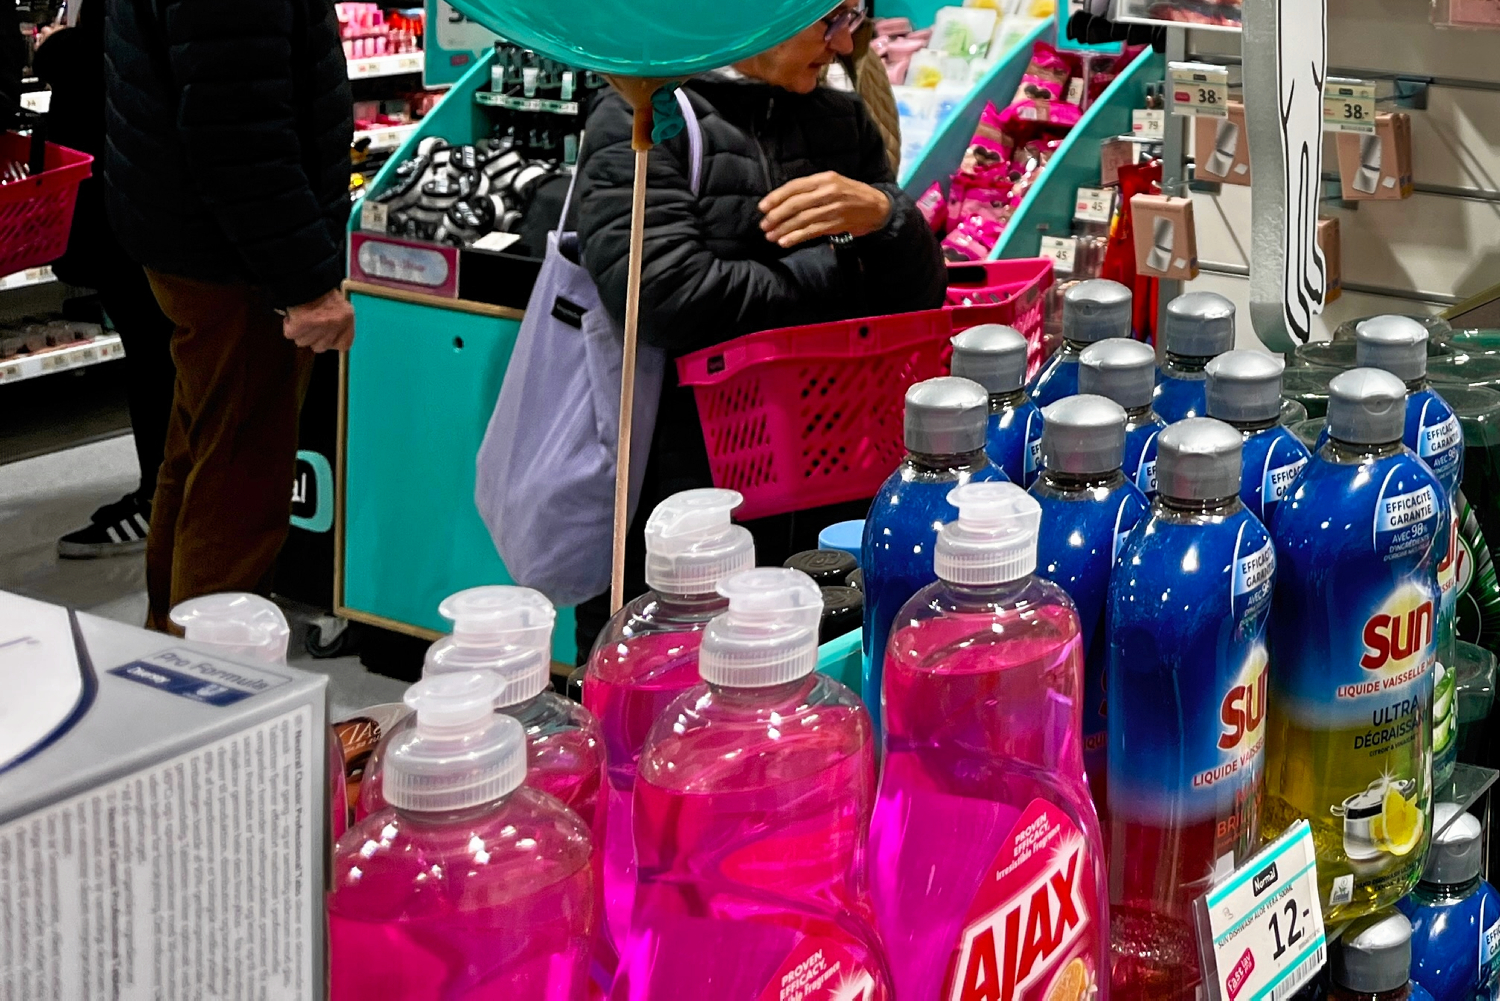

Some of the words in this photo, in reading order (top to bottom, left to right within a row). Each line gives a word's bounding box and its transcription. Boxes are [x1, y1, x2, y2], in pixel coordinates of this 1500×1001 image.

[1271, 465, 1303, 485] EFFICAC
[1386, 489, 1432, 514] EFFICACITÉ
[1390, 504, 1432, 527] GARANTIE
[1392, 531, 1411, 544] AVEC
[153, 652, 191, 668] Pro
[192, 658, 269, 691] Formula
[1337, 680, 1380, 698] LIQUIDE
[1382, 661, 1426, 689] VAISSELLE
[1372, 694, 1419, 727] ULTRA
[1193, 759, 1238, 787] LIQUIDE
[1013, 823, 1051, 858] EFFICACY,
[1014, 812, 1047, 846] PROVEN
[1254, 866, 1276, 892] Normal
[961, 845, 1081, 1001] AJAX
[1218, 936, 1229, 949] SUN
[1229, 916, 1254, 941] DISHWASH
[1254, 905, 1266, 920] ALOE
[1266, 895, 1279, 910] VERA
[1268, 898, 1310, 961] 12,-
[781, 949, 823, 984] PROVEN
[1227, 966, 1244, 992] fast
